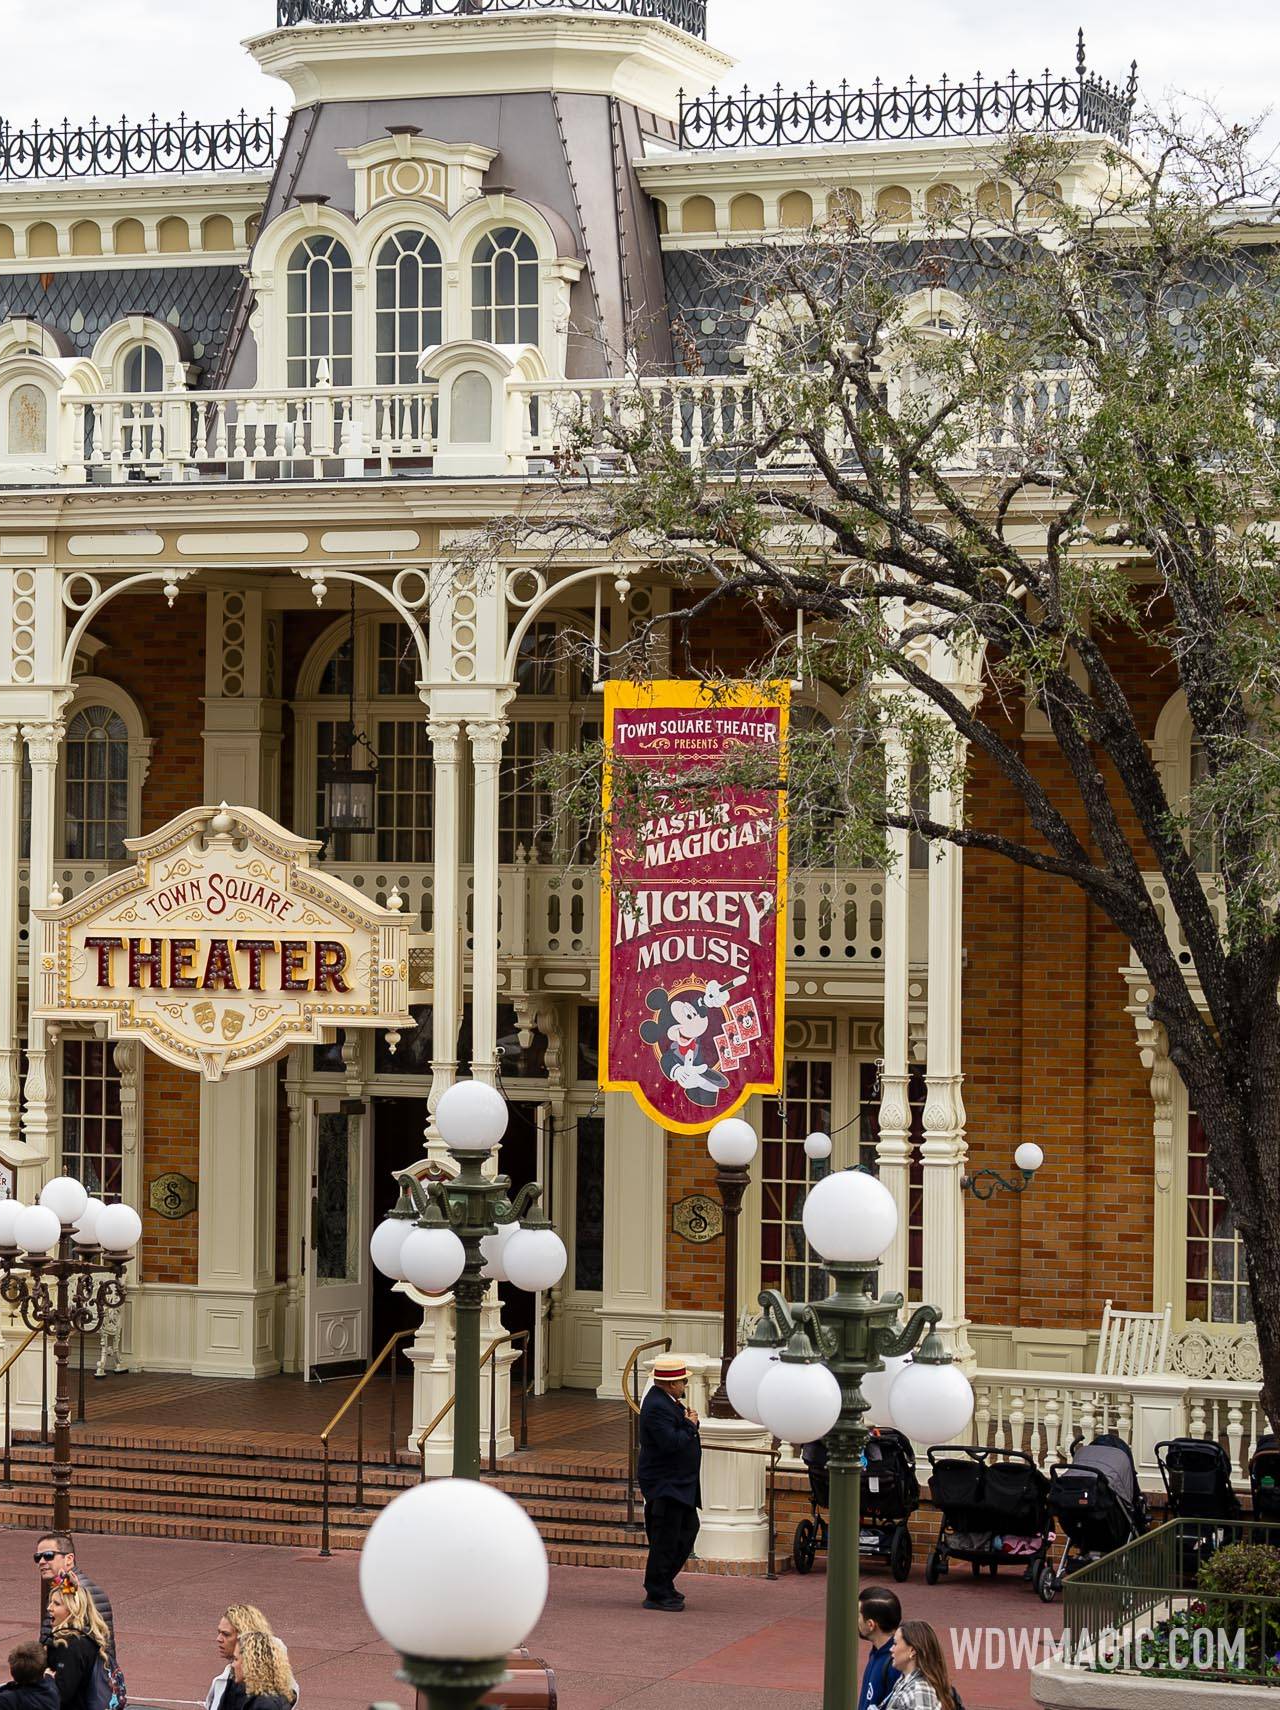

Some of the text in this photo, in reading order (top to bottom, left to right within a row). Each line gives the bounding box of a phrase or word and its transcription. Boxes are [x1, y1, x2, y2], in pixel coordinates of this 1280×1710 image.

[617, 720, 777, 744] TOWN SQUARE THEATER
[674, 739, 718, 749] PRESENTS
[643, 817, 774, 869] MAGICIAN
[146, 873, 296, 921] TOWN SQUARE
[614, 891, 774, 946] MICKEY
[84, 937, 354, 993] THEATER
[636, 936, 750, 974] MOUSE
